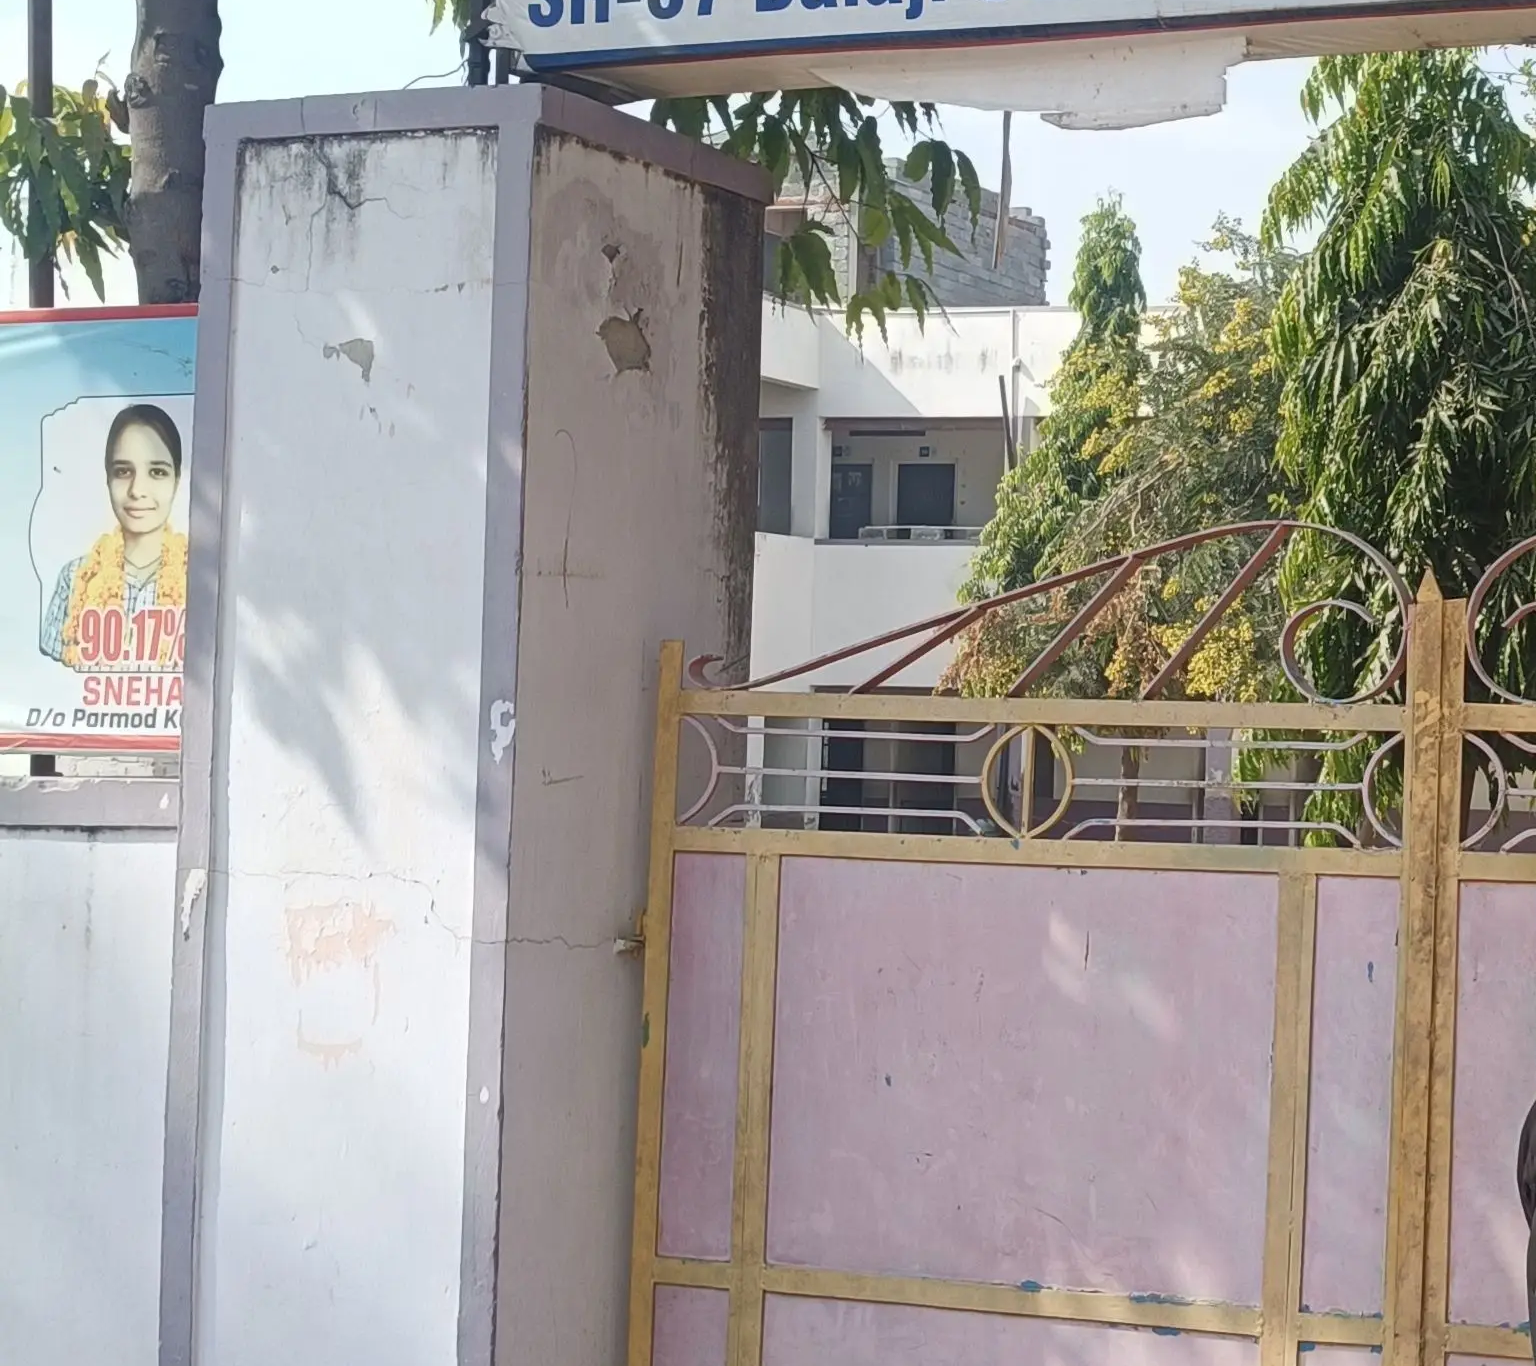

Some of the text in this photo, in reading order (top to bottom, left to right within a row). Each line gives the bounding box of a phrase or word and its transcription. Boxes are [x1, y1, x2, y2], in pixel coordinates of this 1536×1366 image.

[81, 609, 187, 662] 90.17%
[82, 676, 183, 706] SNEHA
[26, 708, 183, 729] D/o Parmod K
